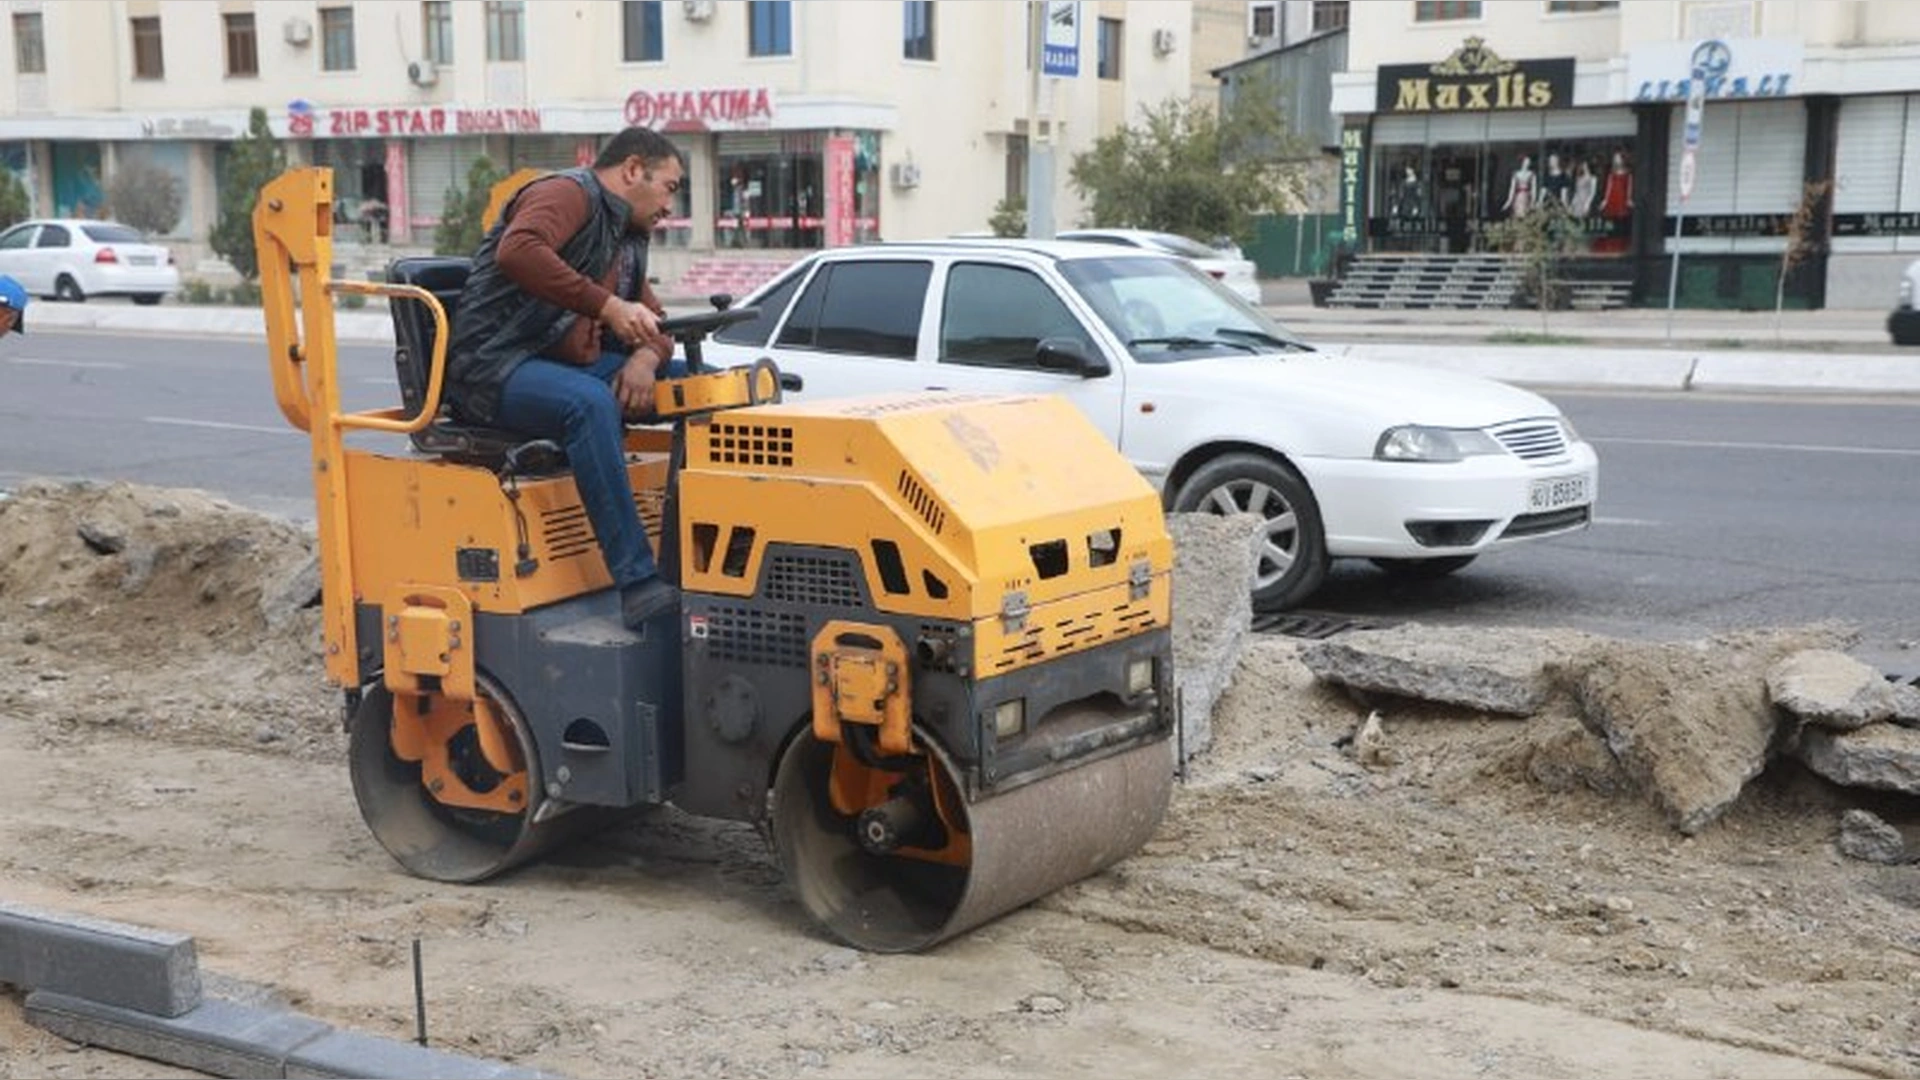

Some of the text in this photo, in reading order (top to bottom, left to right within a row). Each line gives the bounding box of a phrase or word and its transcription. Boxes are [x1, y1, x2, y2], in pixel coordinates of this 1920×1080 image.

[656, 88, 773, 121] HAKIMA
[1395, 73, 1552, 112] Maxlis
[330, 111, 369, 133] ZIP
[377, 109, 446, 133] STAR
[457, 108, 541, 131] EDUCATION
